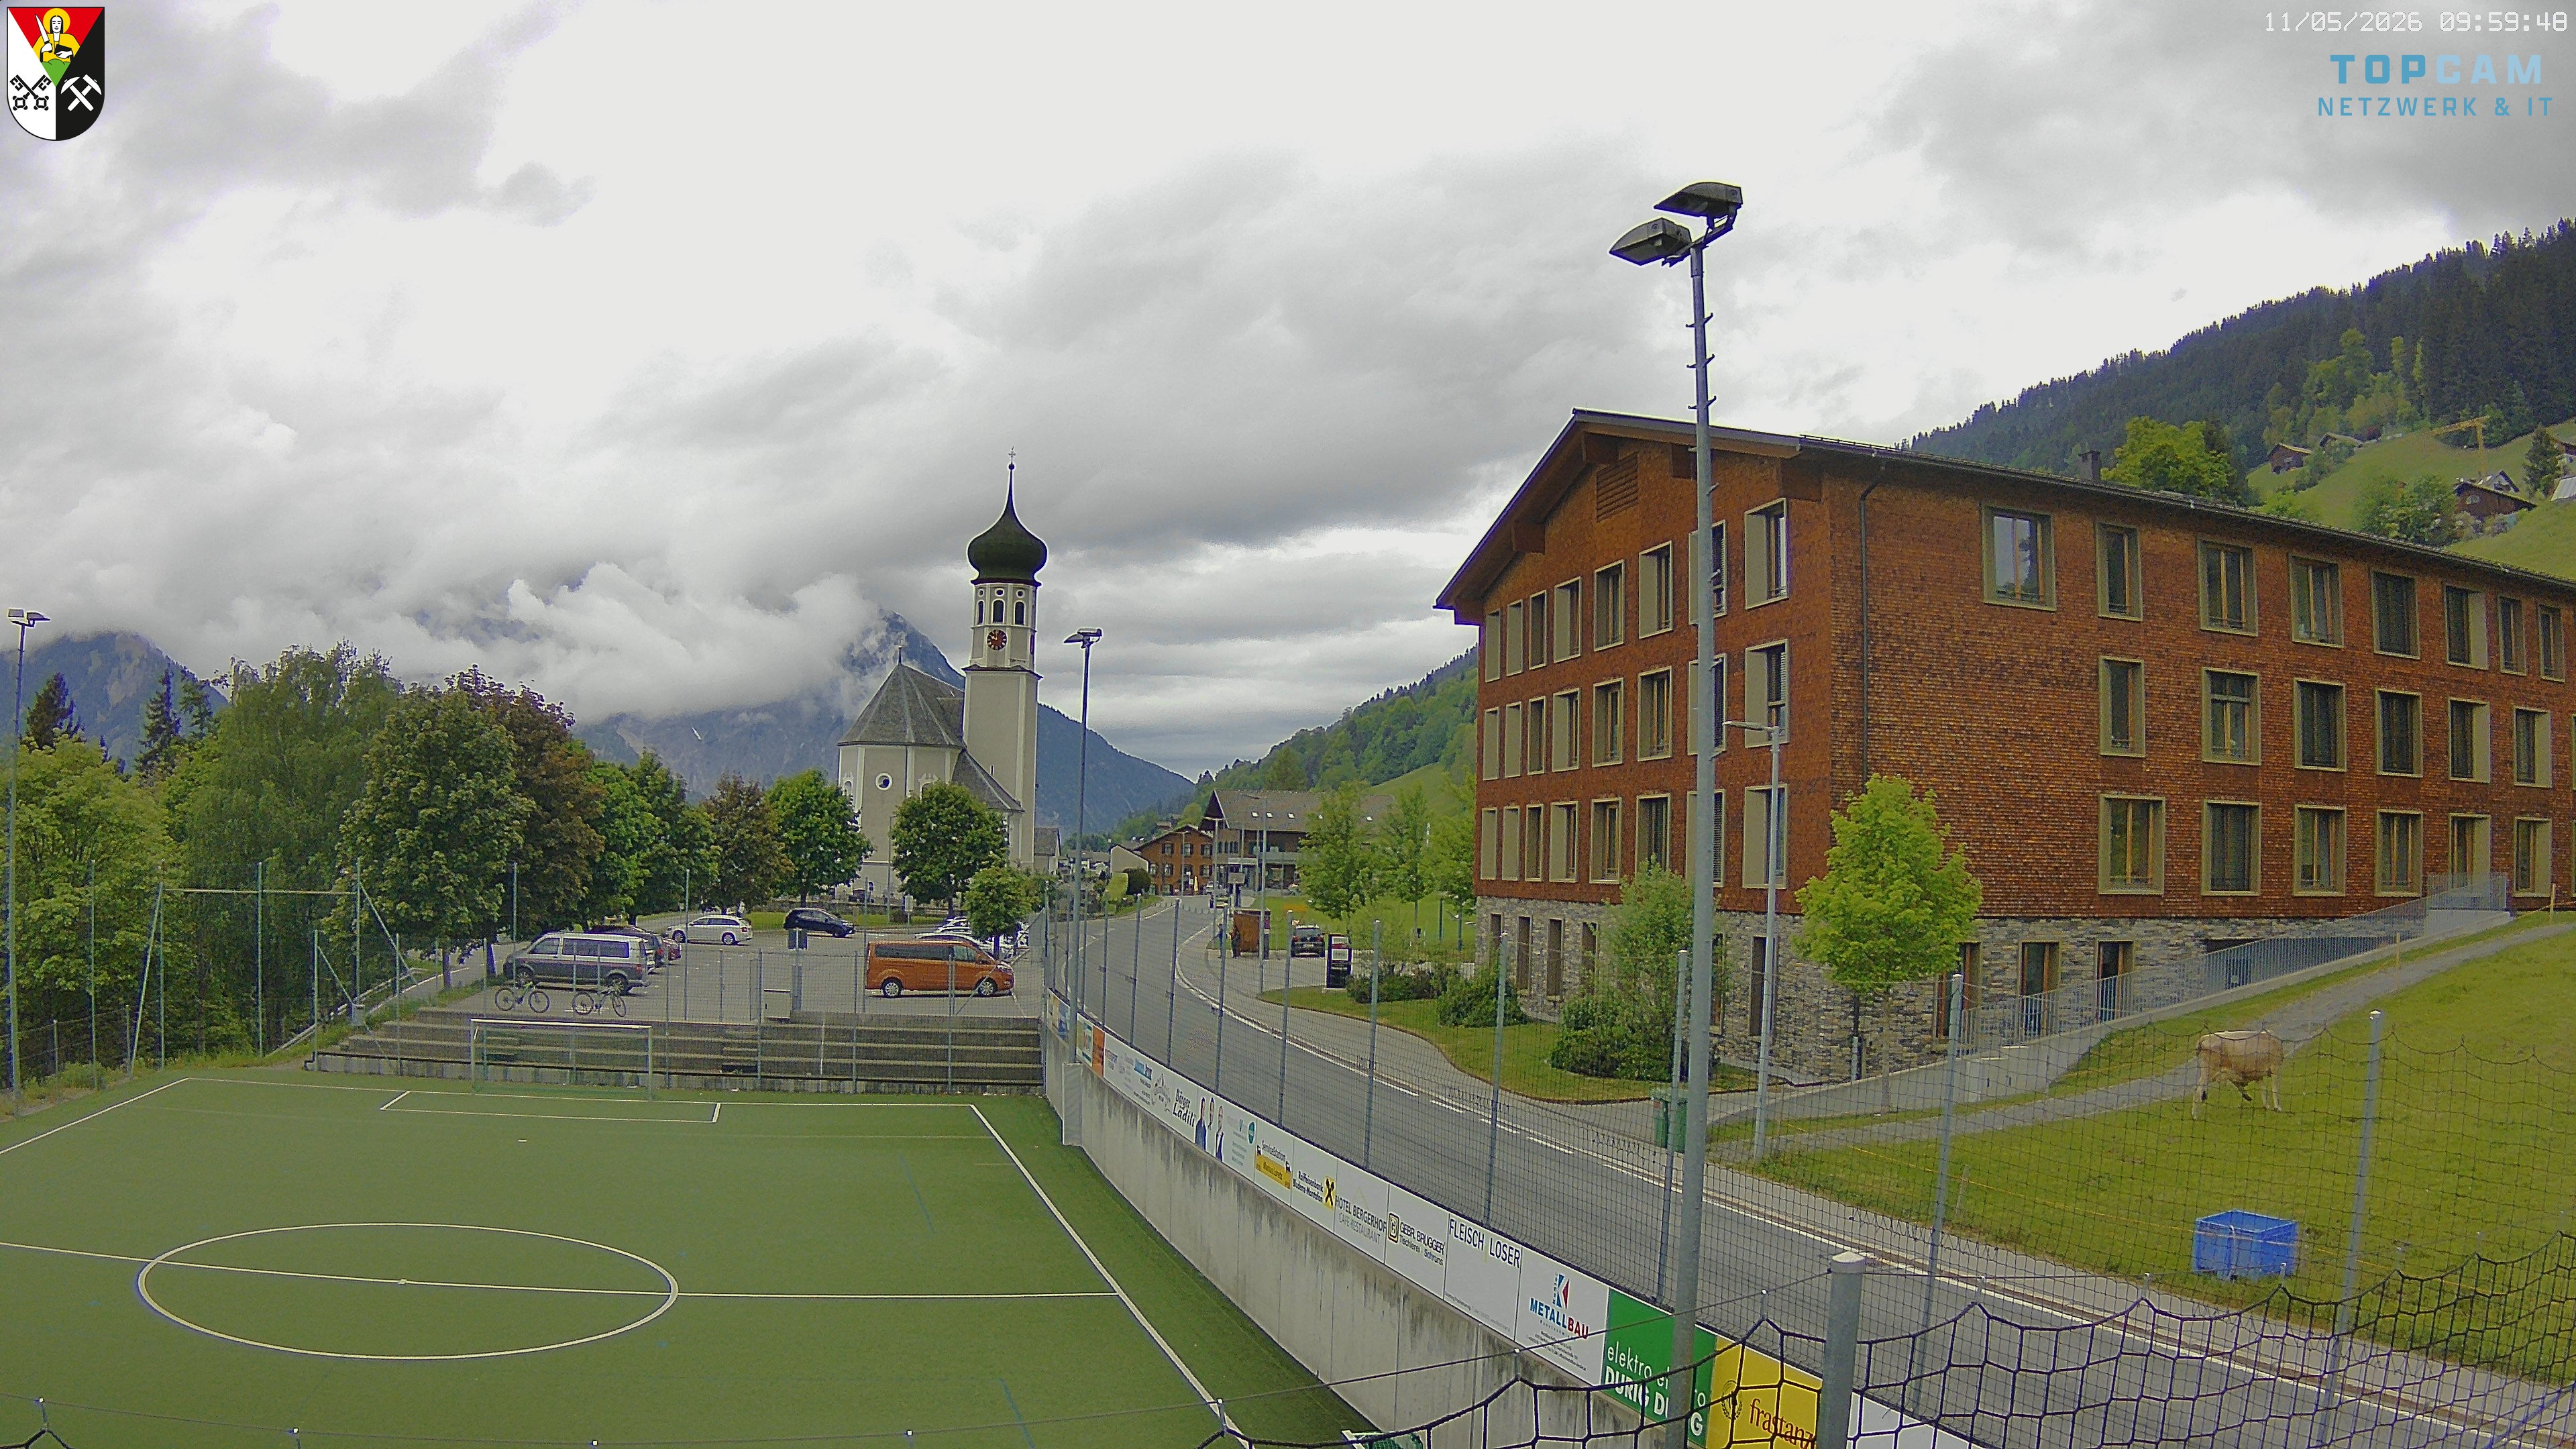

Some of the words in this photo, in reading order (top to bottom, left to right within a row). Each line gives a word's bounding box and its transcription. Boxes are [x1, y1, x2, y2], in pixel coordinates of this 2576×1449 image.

[1336, 1195, 1352, 1215] HOTEL
[1352, 1205, 1387, 1233] BERGERHOF
[1449, 1218, 1485, 1251] FLEISCH
[1489, 1237, 1521, 1268] LOSER
[1529, 1297, 1589, 1340] METALLBAU
[1607, 1340, 1652, 1379] elektro
